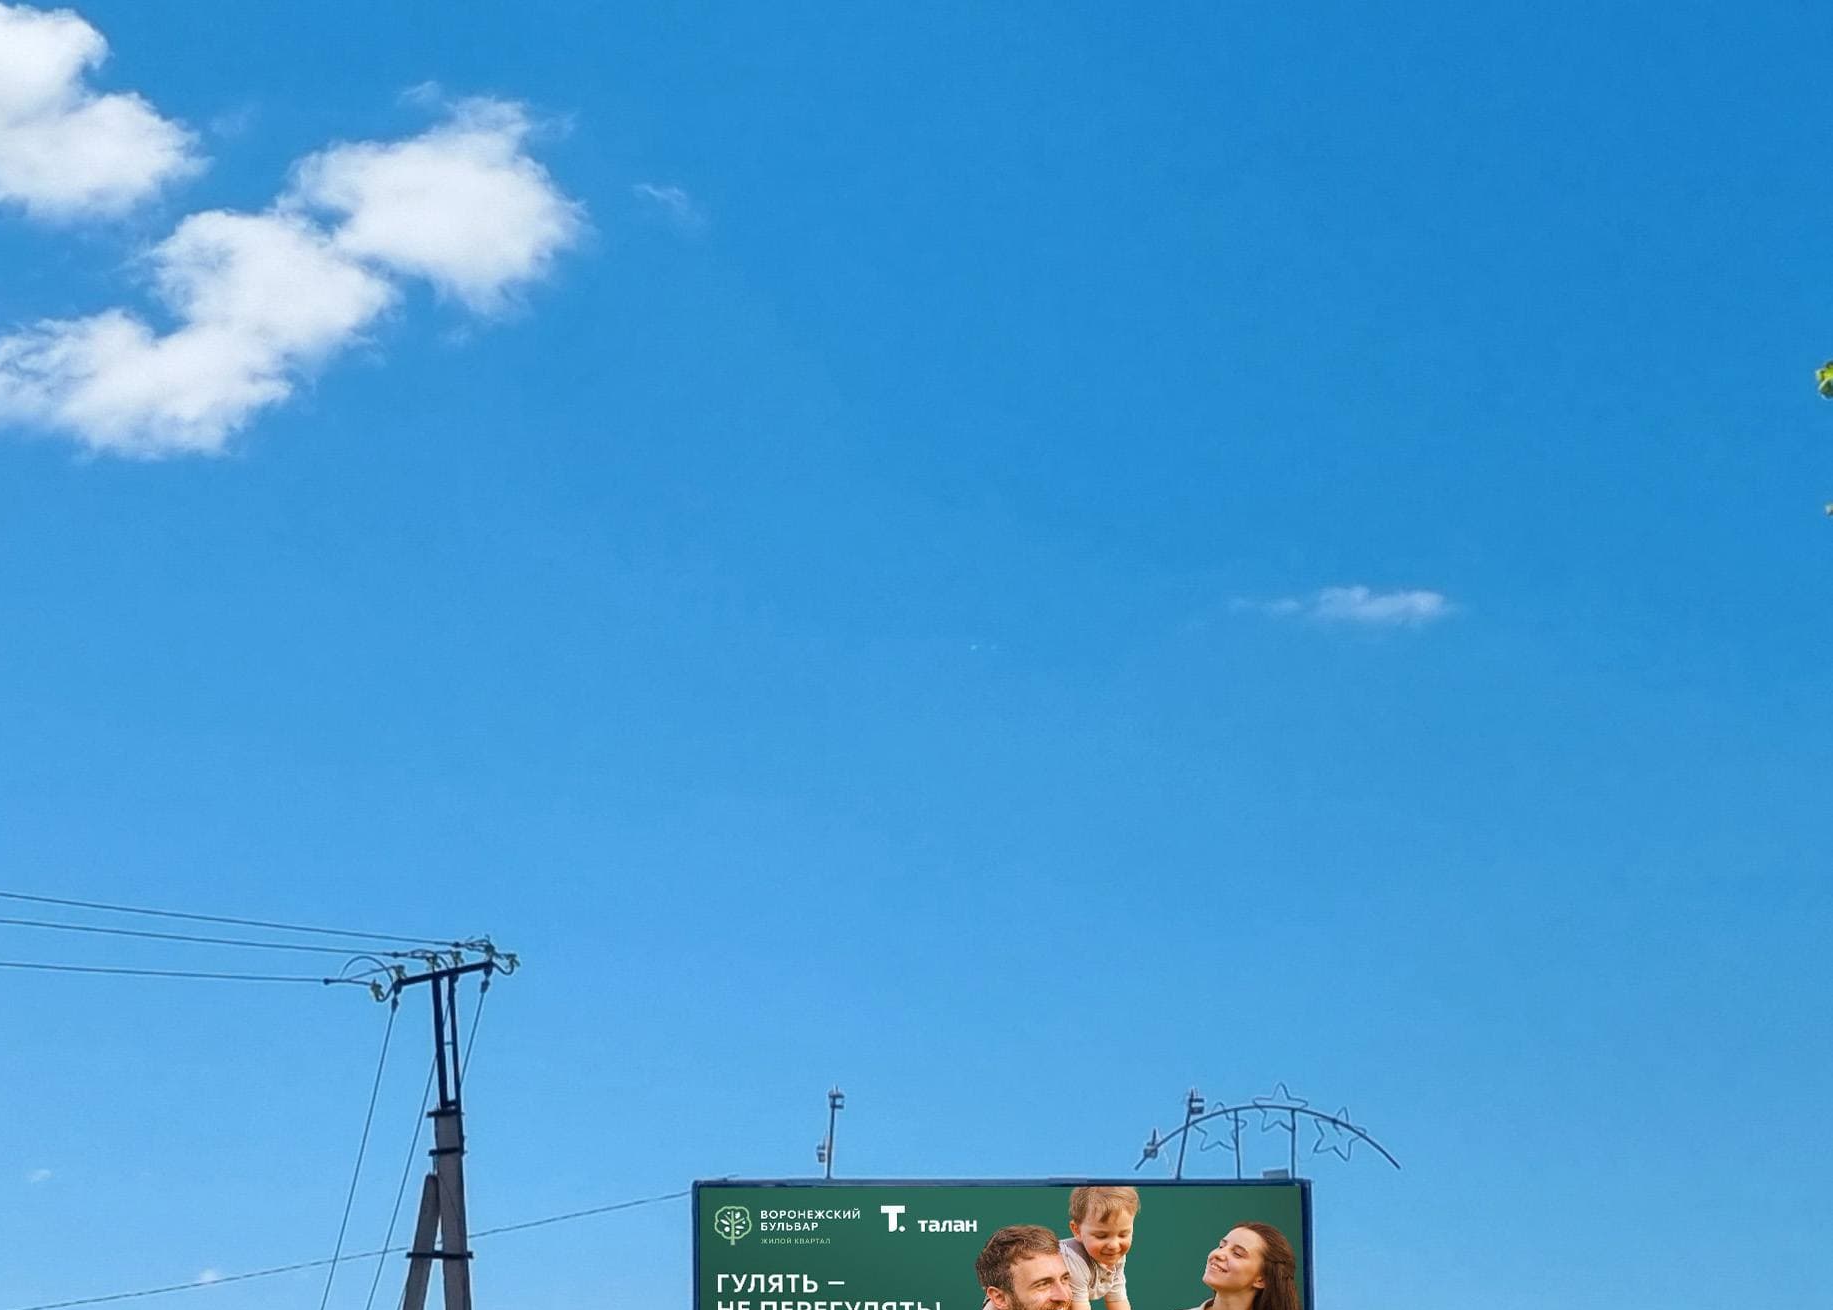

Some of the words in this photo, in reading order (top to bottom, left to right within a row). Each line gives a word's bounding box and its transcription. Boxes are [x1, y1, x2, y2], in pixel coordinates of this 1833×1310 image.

[760, 1207, 861, 1220] ВОРОНЕЖСКИЙ
[760, 1222, 819, 1232] БУЛЬВАР
[917, 1219, 978, 1233] талан
[760, 1236, 792, 1245] ЖИЛОЙ
[794, 1237, 831, 1245] КВАРТАЛ
[717, 1273, 819, 1293] ГУЛЯТЬ
